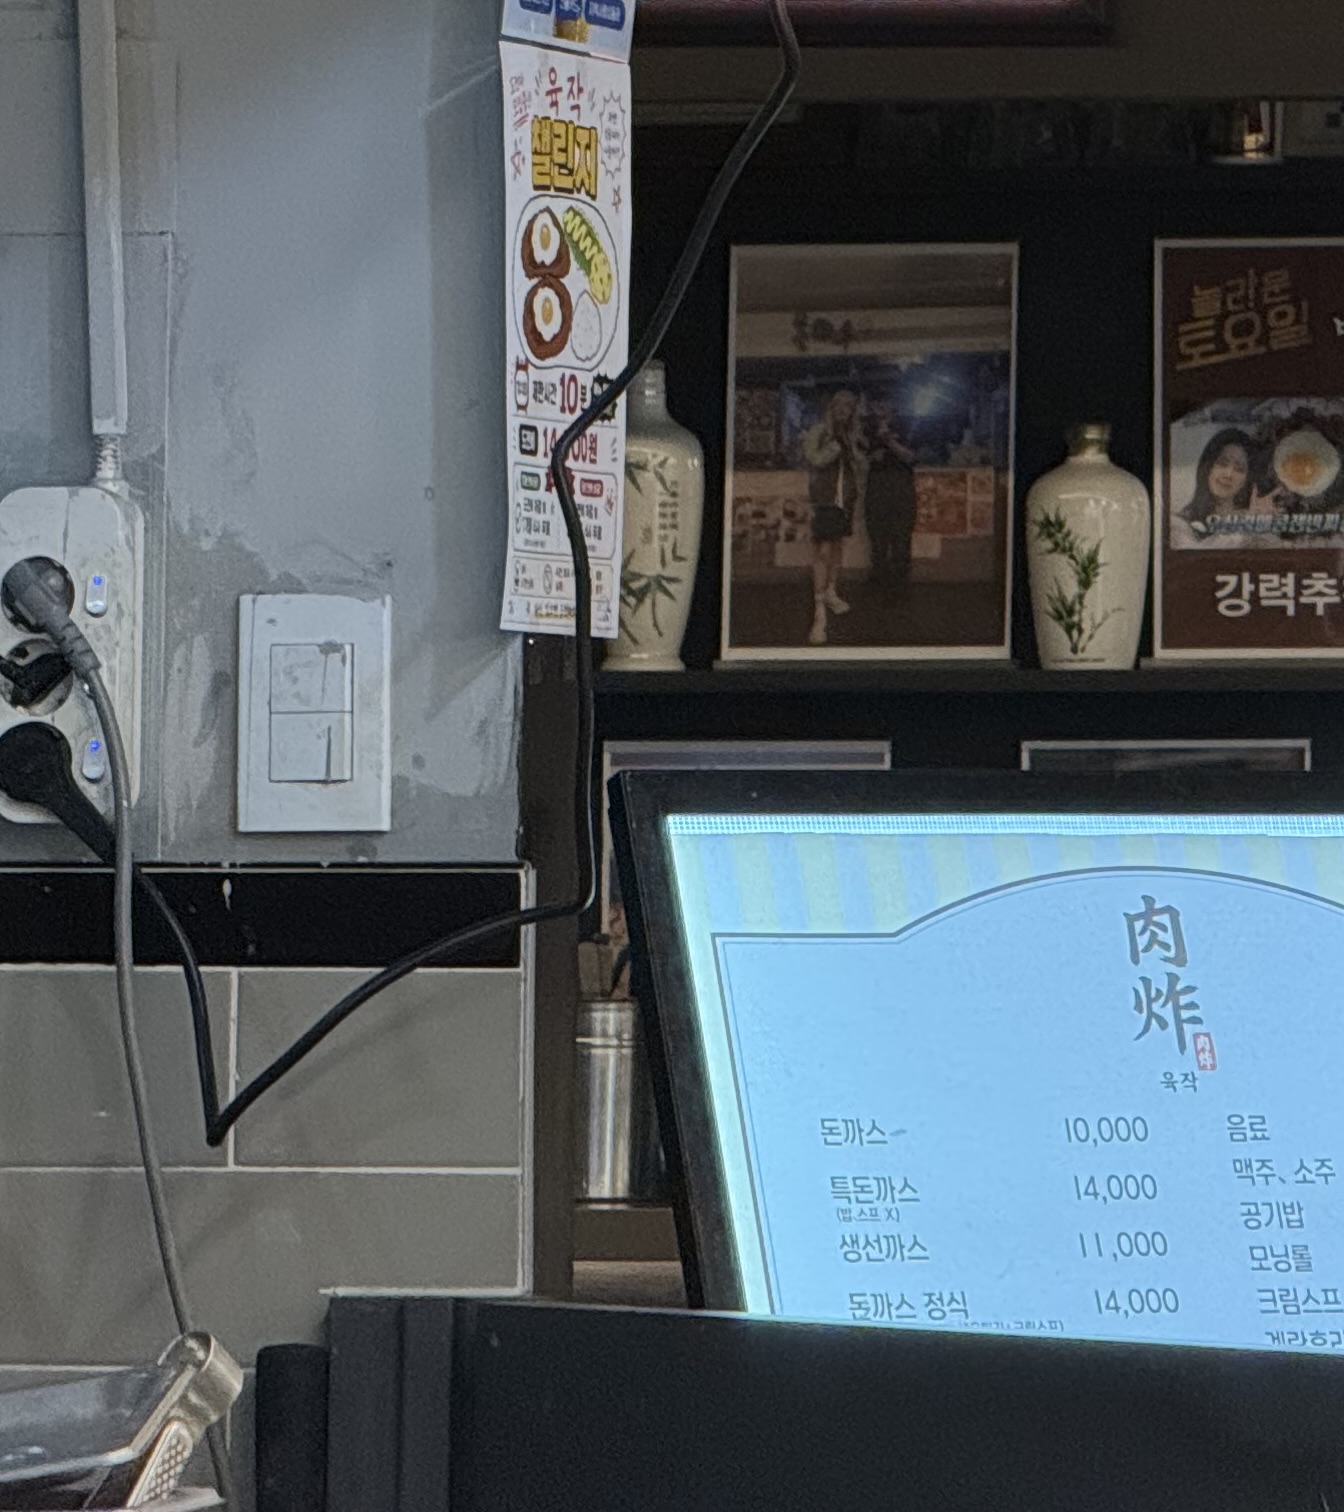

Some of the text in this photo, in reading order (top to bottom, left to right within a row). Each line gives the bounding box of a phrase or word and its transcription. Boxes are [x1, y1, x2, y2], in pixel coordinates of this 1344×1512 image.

[1123, 894, 1204, 1056] 肉炸
[1160, 1071, 1199, 1093] 육작
[819, 1116, 1149, 1147] 돈까스 10,000
[1227, 1113, 1271, 1143] 음료
[830, 1174, 1158, 1205] 특돈까스 14,000
[1240, 1200, 1304, 1230] 공기밥
[839, 1231, 1168, 1263] 생선까스 11,000
[1249, 1244, 1313, 1272] 모닝롤
[848, 1287, 1179, 1321] 돈까스 정식 14,000
[1257, 1288, 1344, 1315] 크림스프
